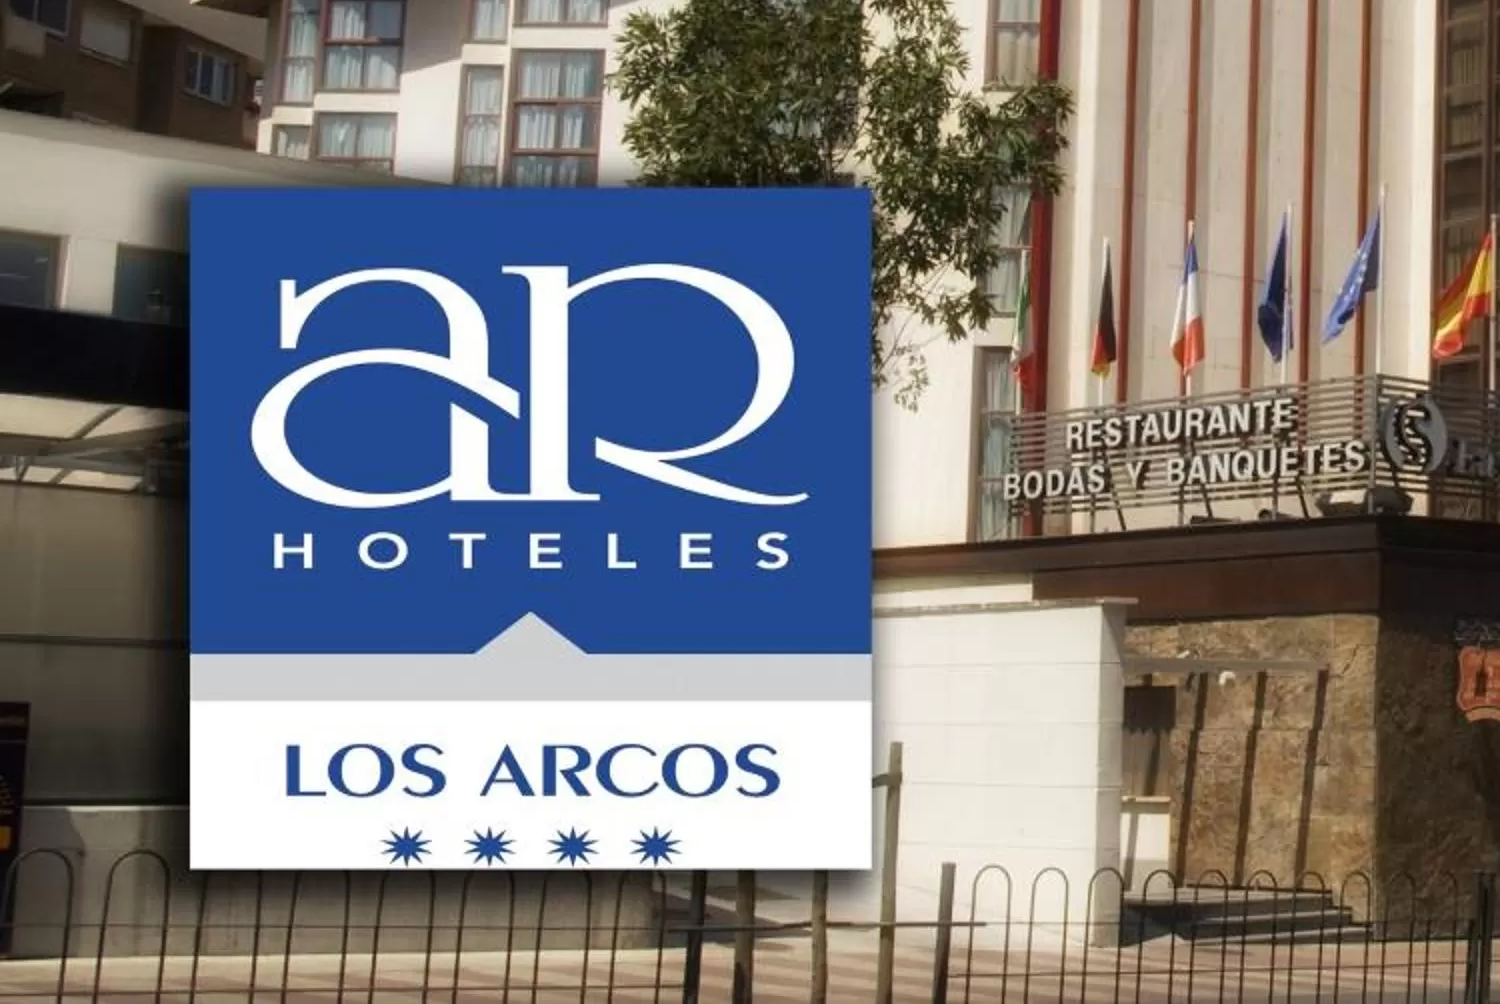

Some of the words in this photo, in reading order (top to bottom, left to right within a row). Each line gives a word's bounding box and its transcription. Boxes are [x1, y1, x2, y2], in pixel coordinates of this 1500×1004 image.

[1065, 397, 1294, 450] RESTAURANTE
[1004, 463, 1107, 501] BODAS
[1126, 459, 1147, 490] Y
[1166, 439, 1367, 487] BANQUETES
